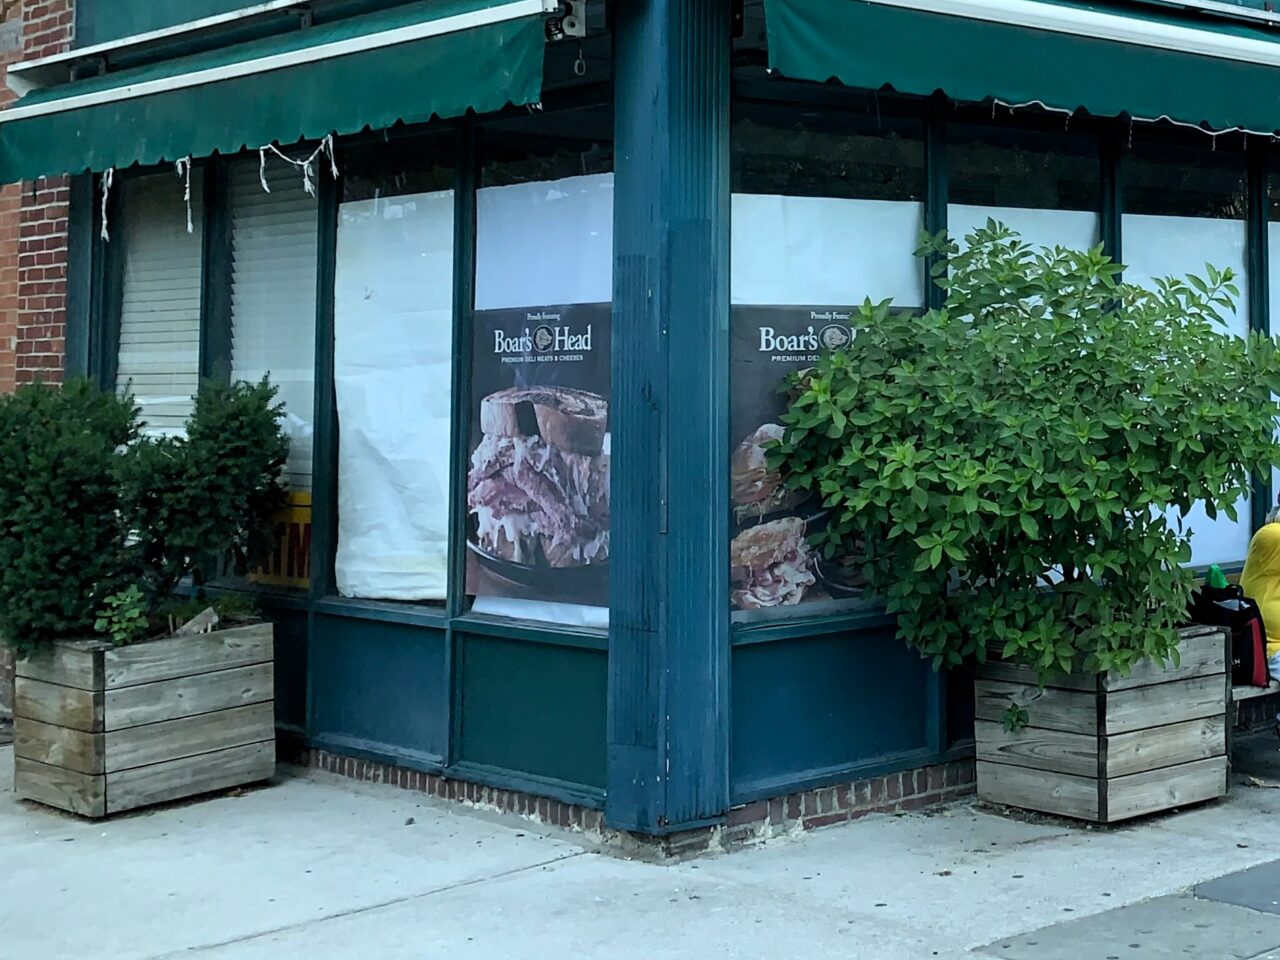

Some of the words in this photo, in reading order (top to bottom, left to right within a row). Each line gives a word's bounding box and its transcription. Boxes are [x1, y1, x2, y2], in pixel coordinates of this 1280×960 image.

[811, 311, 832, 321] Proudly
[494, 327, 532, 353] Boar's
[554, 324, 592, 351] Head
[759, 326, 818, 351] Boar's
